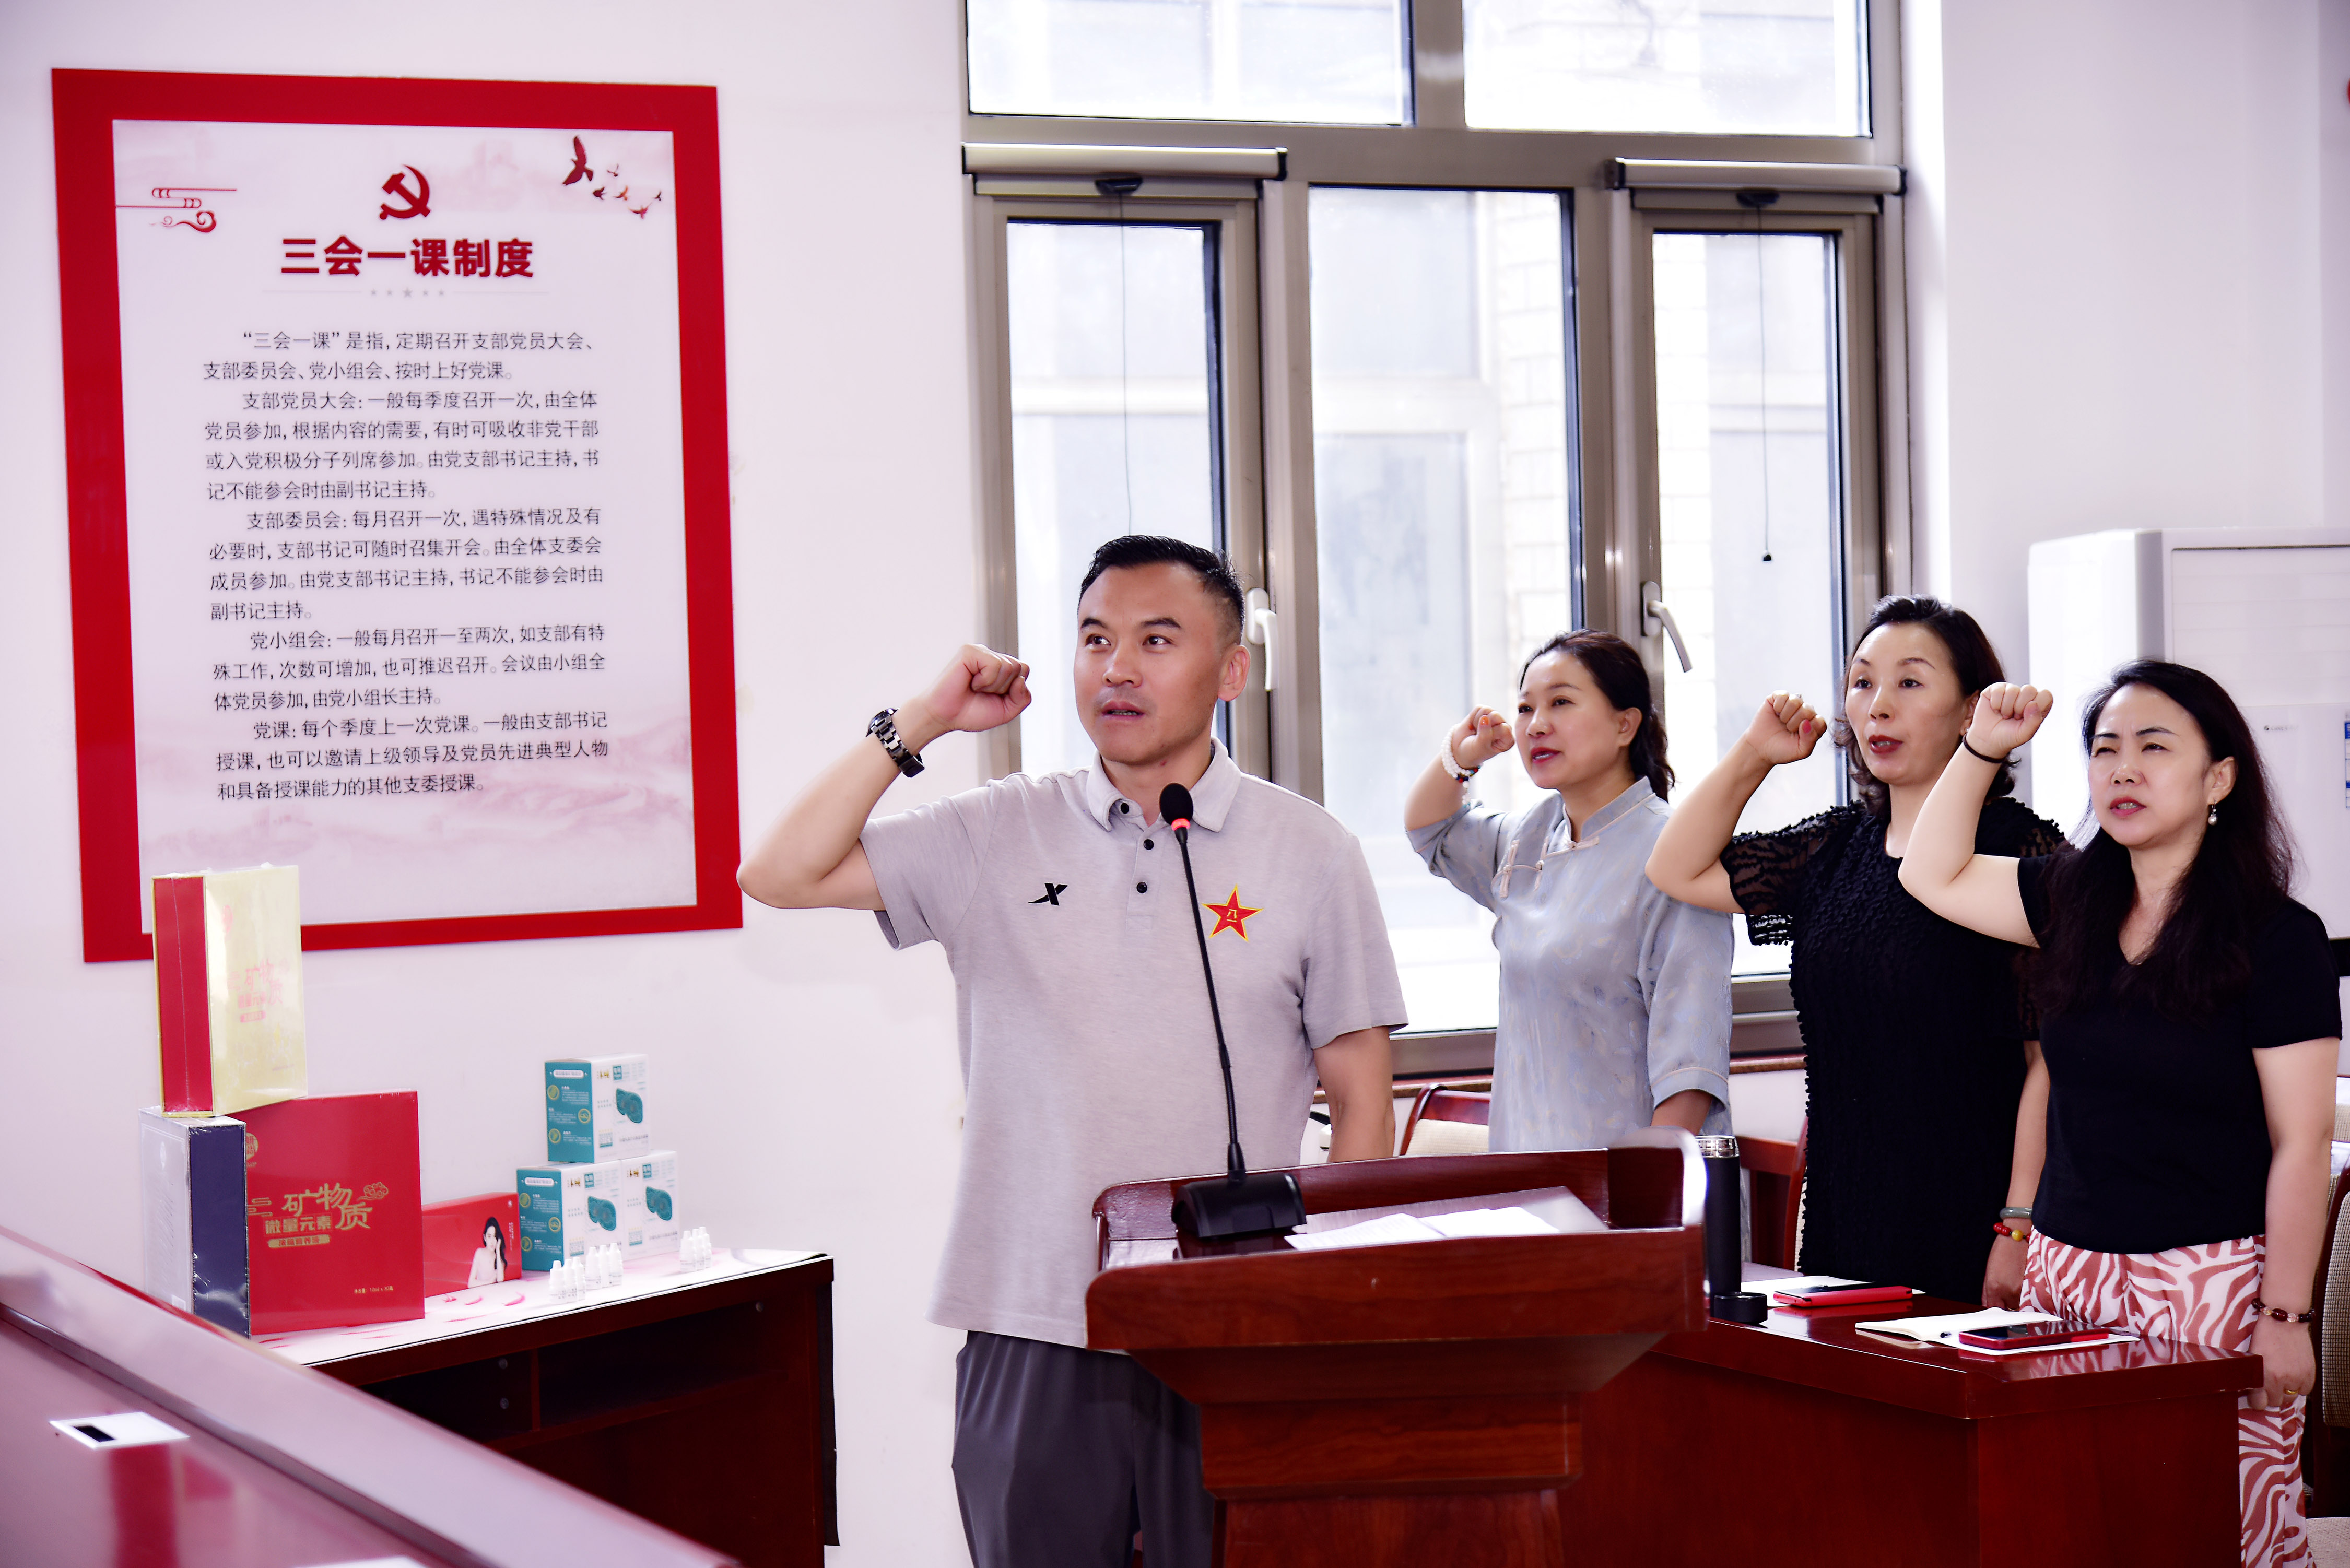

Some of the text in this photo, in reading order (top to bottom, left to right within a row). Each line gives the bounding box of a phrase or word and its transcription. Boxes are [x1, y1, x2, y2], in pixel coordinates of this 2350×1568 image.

[280, 234, 535, 279] 三会一课制度
[203, 360, 511, 380] 支部委员会、党小组会、按时上好党课。
[207, 479, 435, 500] 记不能参会时由副书记主持。
[210, 600, 312, 621] 副书记主持。
[217, 773, 484, 801] 和具备授课能力的其他支委授课。
[281, 1182, 373, 1230] 矿物质
[265, 1216, 332, 1234] 微量元素
